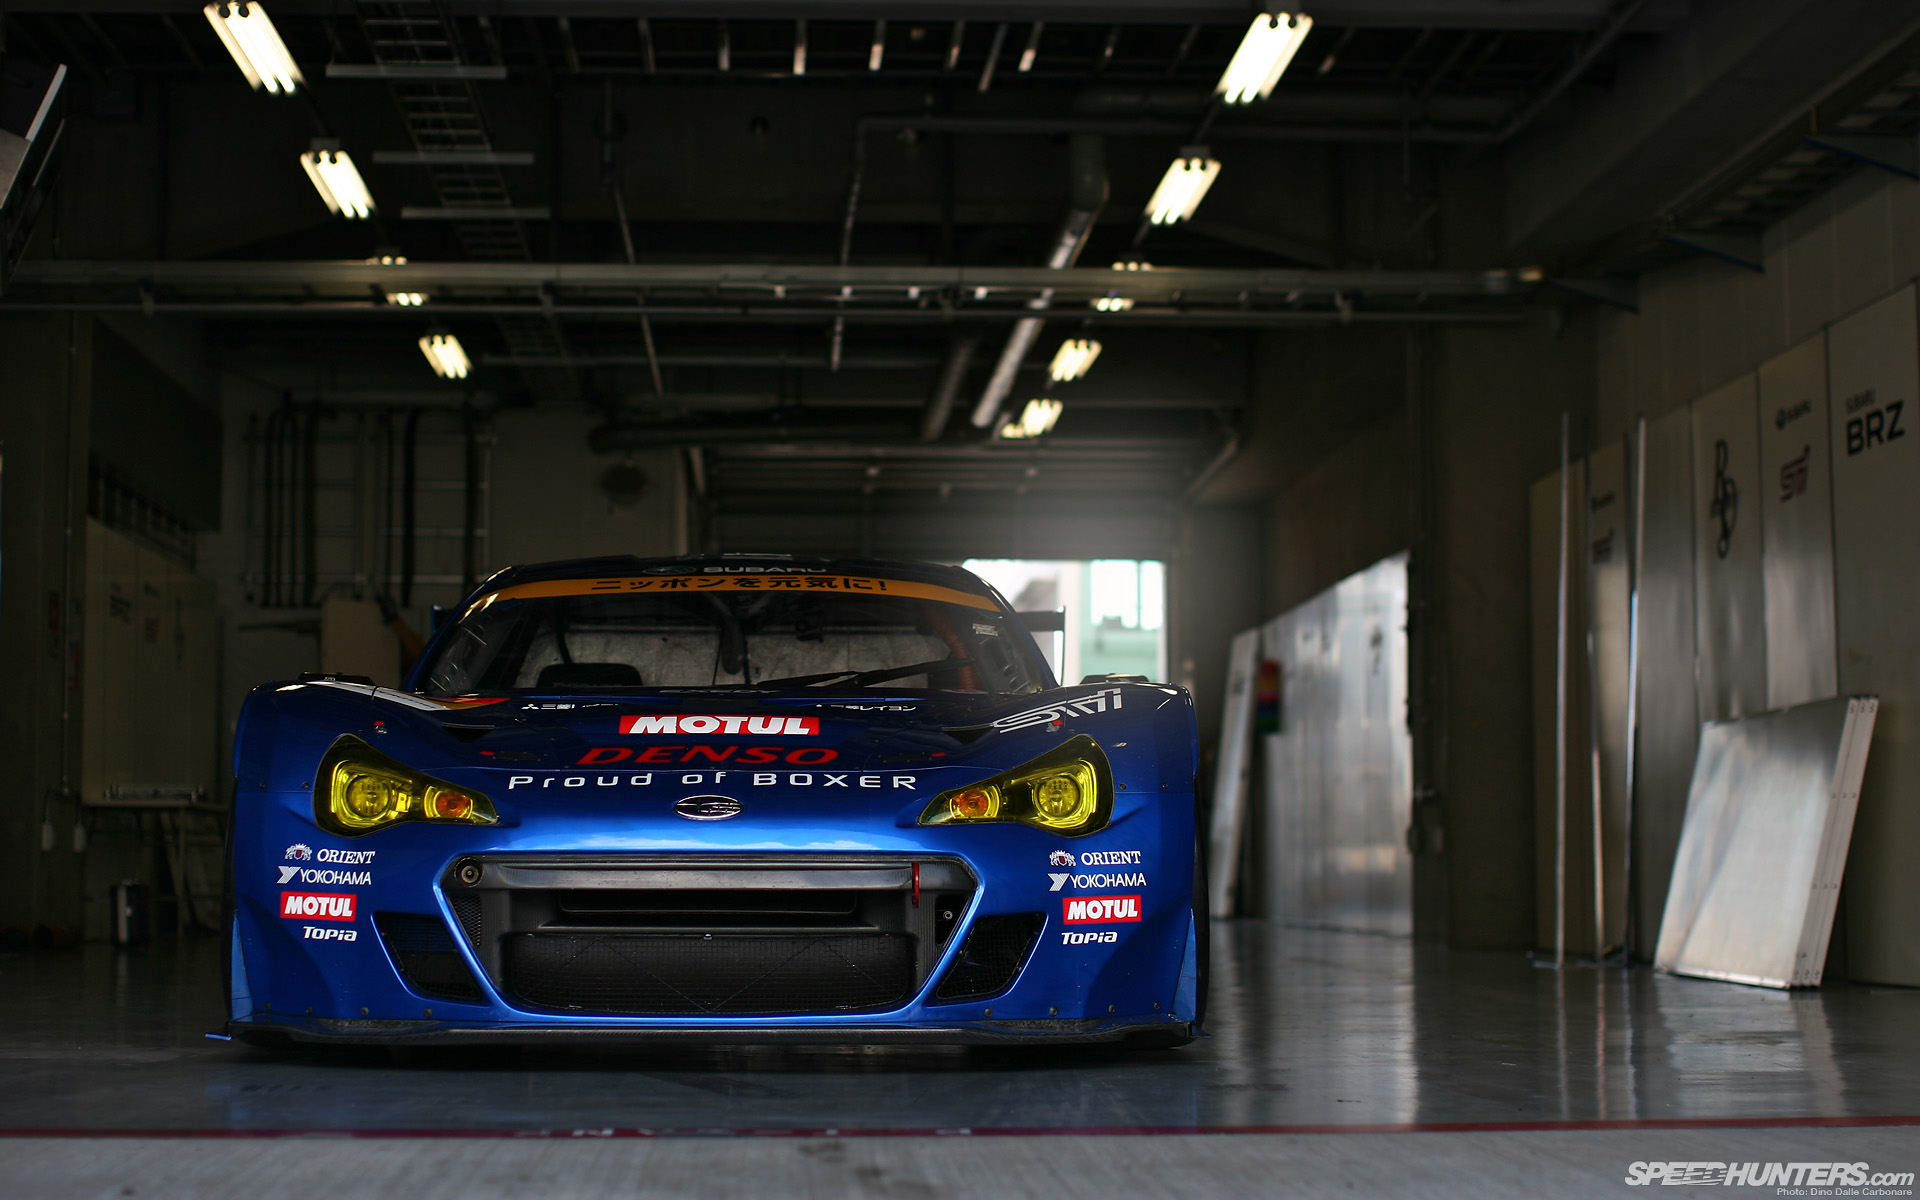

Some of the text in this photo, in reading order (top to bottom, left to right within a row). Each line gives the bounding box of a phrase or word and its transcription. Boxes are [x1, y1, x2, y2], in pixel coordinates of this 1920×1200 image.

[1847, 401, 1904, 456] BRZ
[703, 565, 827, 574] SUBARU
[629, 715, 811, 735] MOTUL
[575, 745, 839, 766] DENSO
[507, 771, 917, 790] Proud of BOXER
[317, 848, 376, 865] ORIENT
[1080, 850, 1141, 866] ORIENT
[300, 868, 372, 886] YOKOHAMA
[1070, 872, 1147, 889] YOKOHAMA
[284, 895, 353, 918] MOTUL
[1067, 898, 1138, 921] MOTUL
